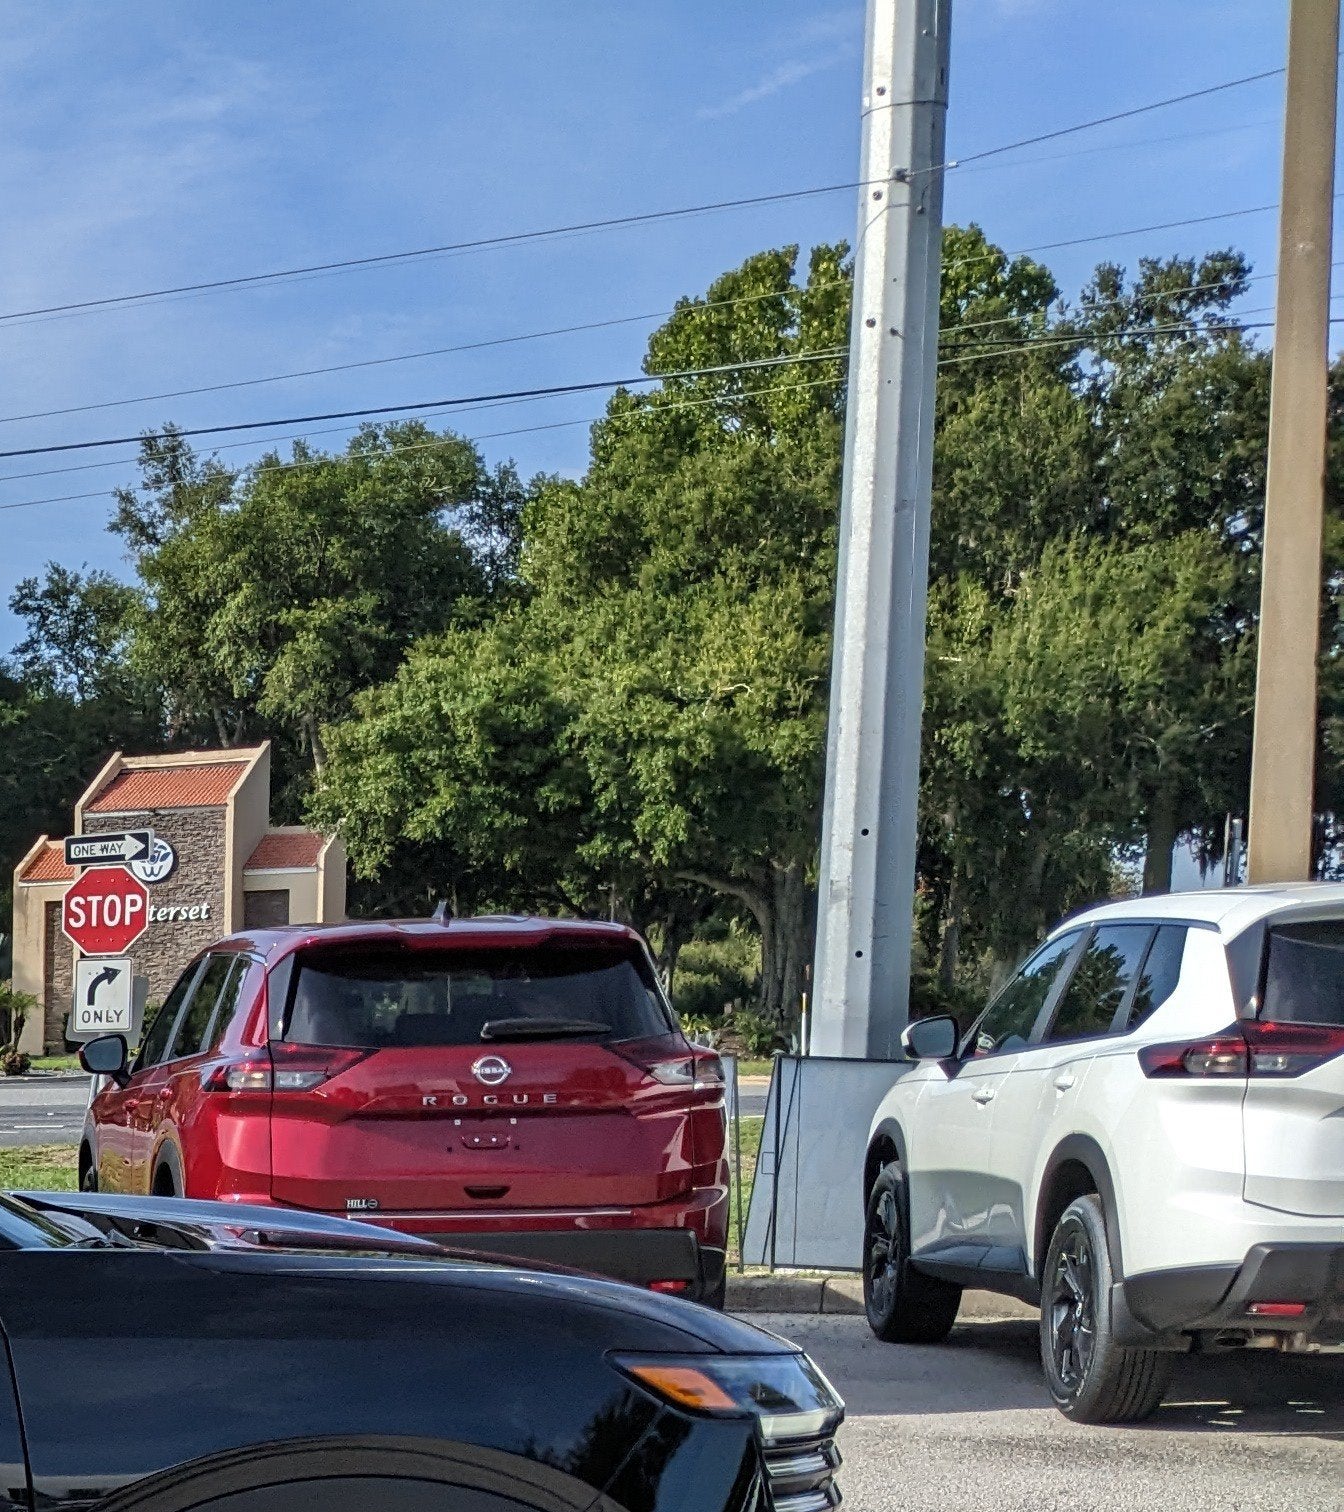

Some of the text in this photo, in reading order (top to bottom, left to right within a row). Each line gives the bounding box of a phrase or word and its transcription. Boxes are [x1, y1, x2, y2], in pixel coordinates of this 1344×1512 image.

[73, 842, 124, 857] ONE WAY
[68, 893, 143, 928] STOP
[148, 902, 211, 922] terset
[81, 1009, 125, 1024] ONLY
[472, 1066, 512, 1075] NISSAN
[422, 1093, 558, 1106] ROGUE
[346, 1198, 368, 1209] HILL
